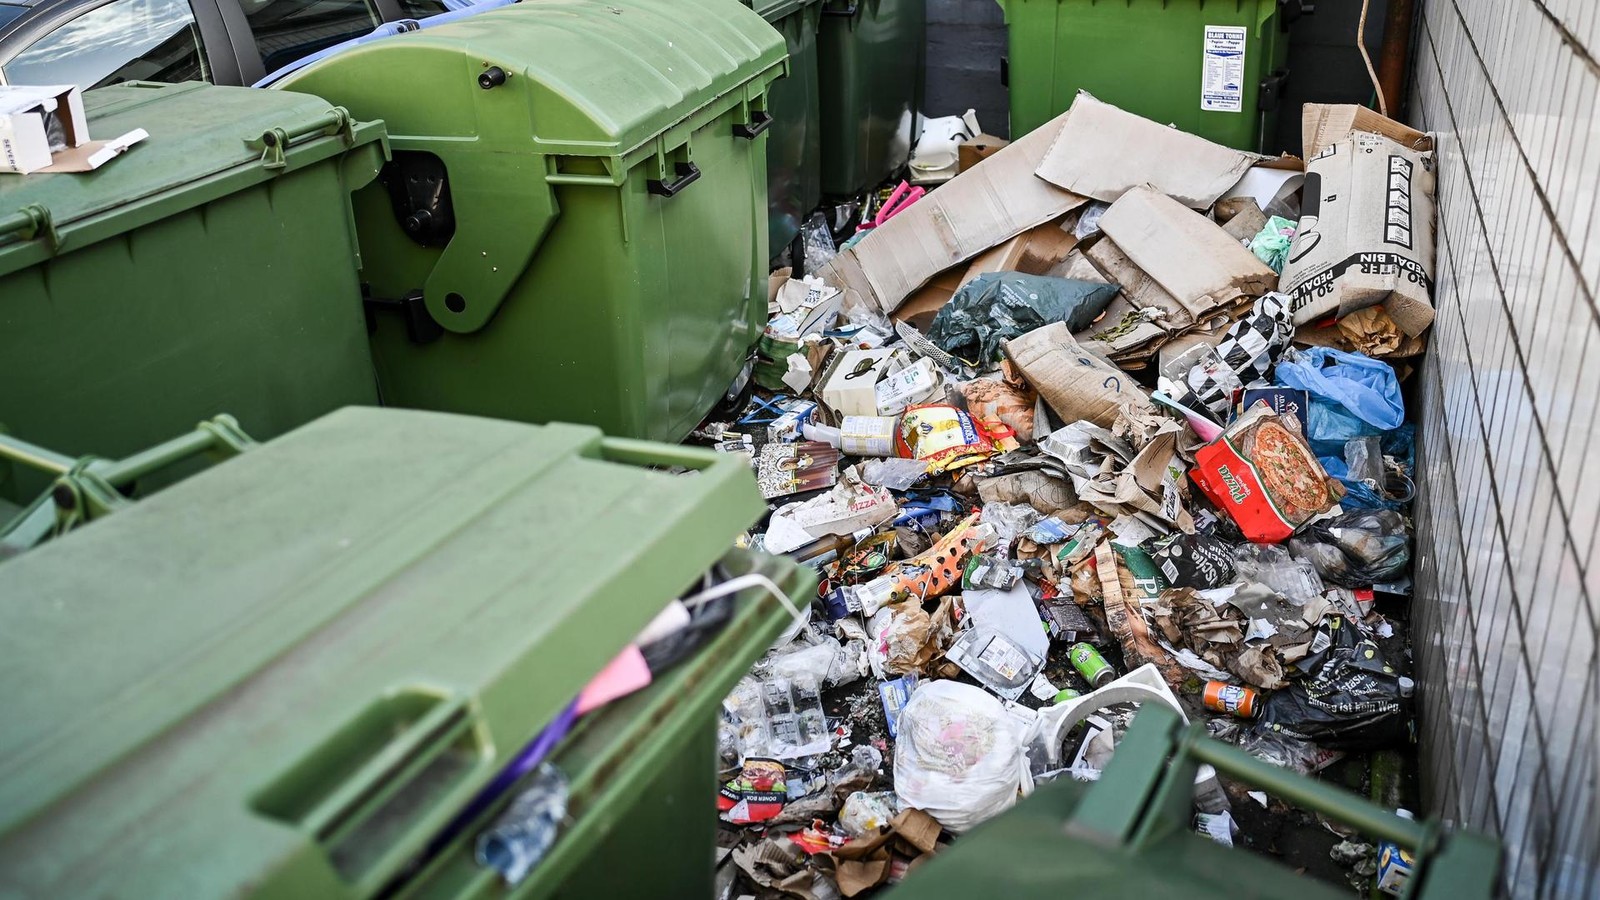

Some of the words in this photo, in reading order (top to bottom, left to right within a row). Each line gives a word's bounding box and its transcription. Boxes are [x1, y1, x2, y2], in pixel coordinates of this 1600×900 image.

[1360, 253, 1386, 263] BIN
[1301, 269, 1334, 293] PEDAL
[1407, 272, 1426, 288] 30
[1317, 281, 1334, 297] 30
[1217, 464, 1247, 504] Pizza
[849, 499, 877, 511] PIZZA
[1340, 702, 1354, 713] ist
[1355, 701, 1376, 713] kein
[1379, 701, 1401, 714] Weg.
